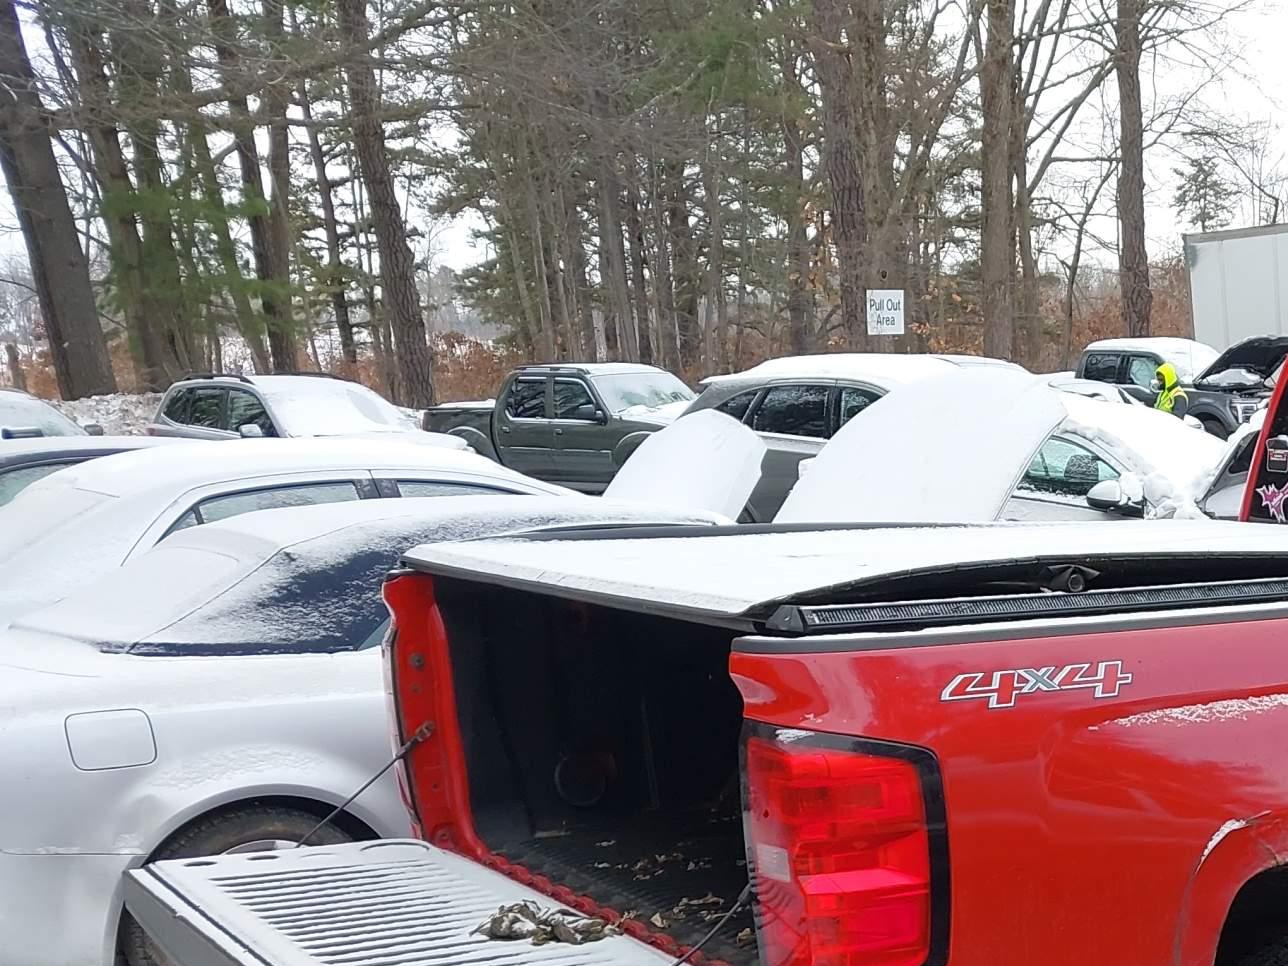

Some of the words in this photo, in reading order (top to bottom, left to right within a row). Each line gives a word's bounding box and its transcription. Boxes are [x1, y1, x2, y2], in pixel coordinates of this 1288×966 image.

[869, 298, 885, 312] Pull
[886, 298, 901, 312] Out
[876, 313, 896, 327] Area
